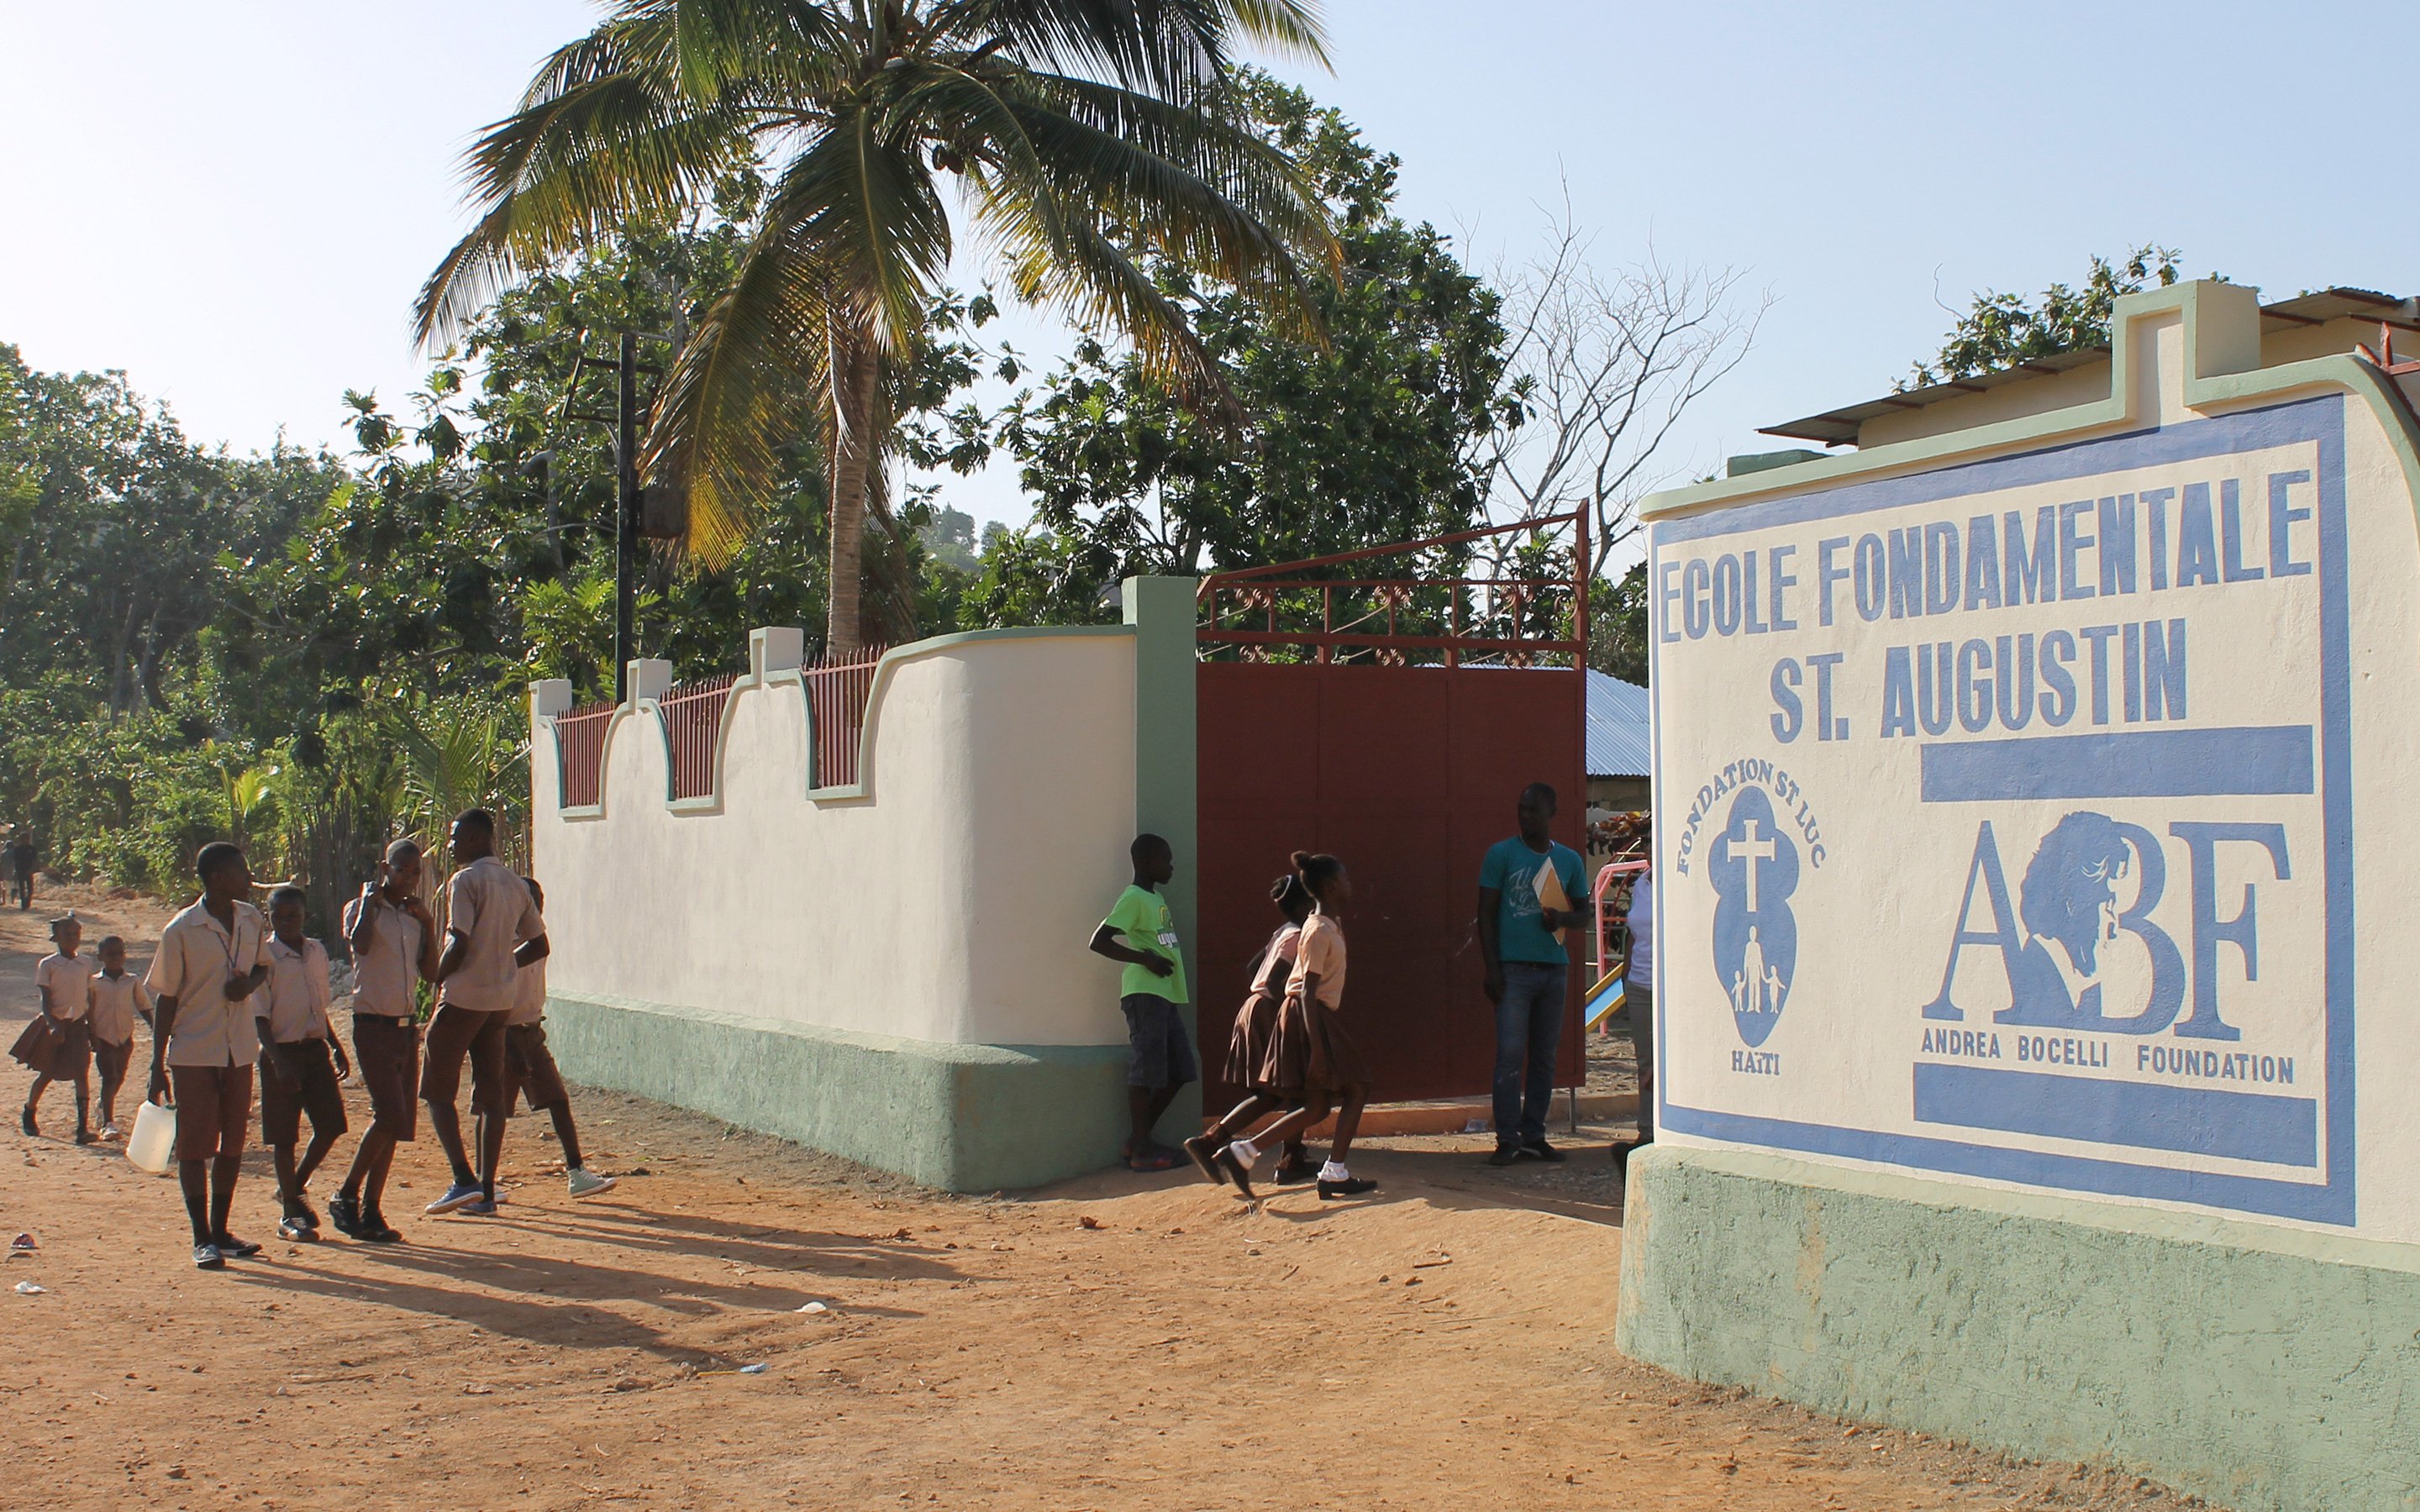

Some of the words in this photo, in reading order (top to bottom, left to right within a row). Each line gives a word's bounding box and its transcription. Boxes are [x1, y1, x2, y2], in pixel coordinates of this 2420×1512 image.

[1660, 543, 1798, 643] ECOLE
[1818, 469, 2312, 627] FONDAMENTALE
[1770, 653, 1849, 744] ST.
[1881, 618, 2186, 739] AUGUSTIN
[1676, 758, 1774, 878] FONDATION
[1775, 770, 1800, 806] ST
[1795, 800, 1826, 869] LUC
[1921, 1027, 2002, 1059] ANDREA
[2018, 1035, 2108, 1068] BOCELLI
[2137, 1044, 2294, 1084] FOUNDATION
